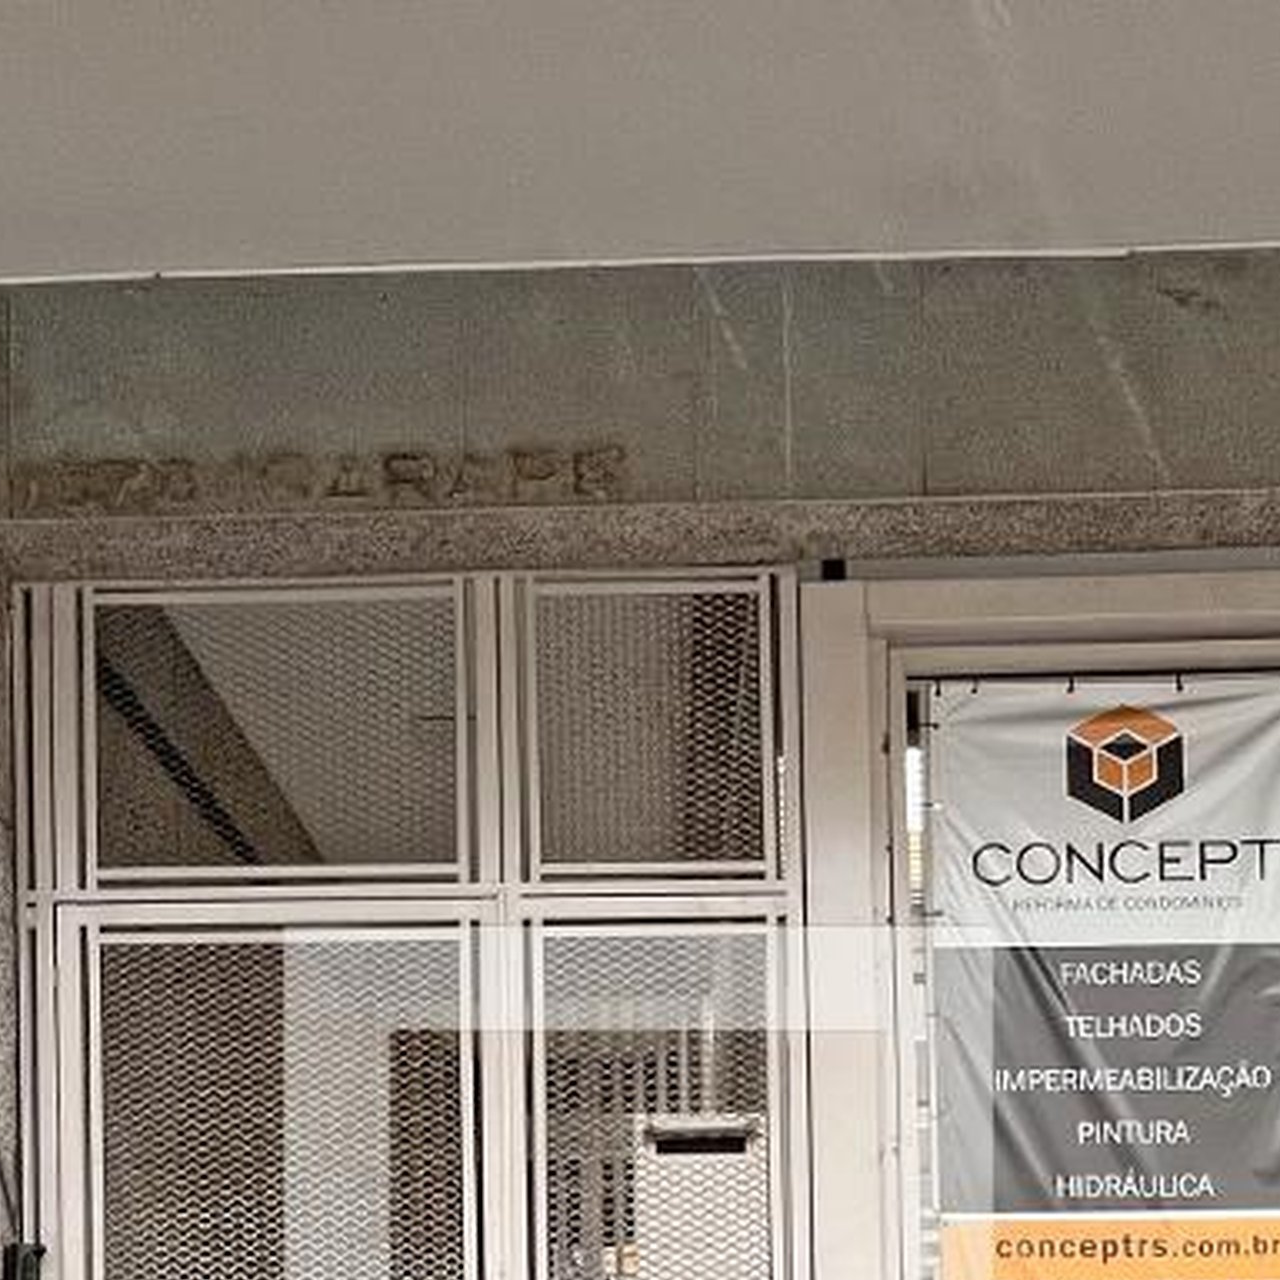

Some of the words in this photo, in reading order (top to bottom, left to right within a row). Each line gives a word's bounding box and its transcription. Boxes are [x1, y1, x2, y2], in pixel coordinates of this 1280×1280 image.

[1061, 958, 1202, 986] FACHADAS
[1065, 1013, 1202, 1039] TELHADOS
[994, 1060, 1272, 1097] IMPERMEABILIZAÇÃO
[1078, 1120, 1191, 1145] PINTURA
[1056, 1167, 1217, 1199] HIDRÁULICA
[995, 1235, 1280, 1263] conceptrs.com.br
